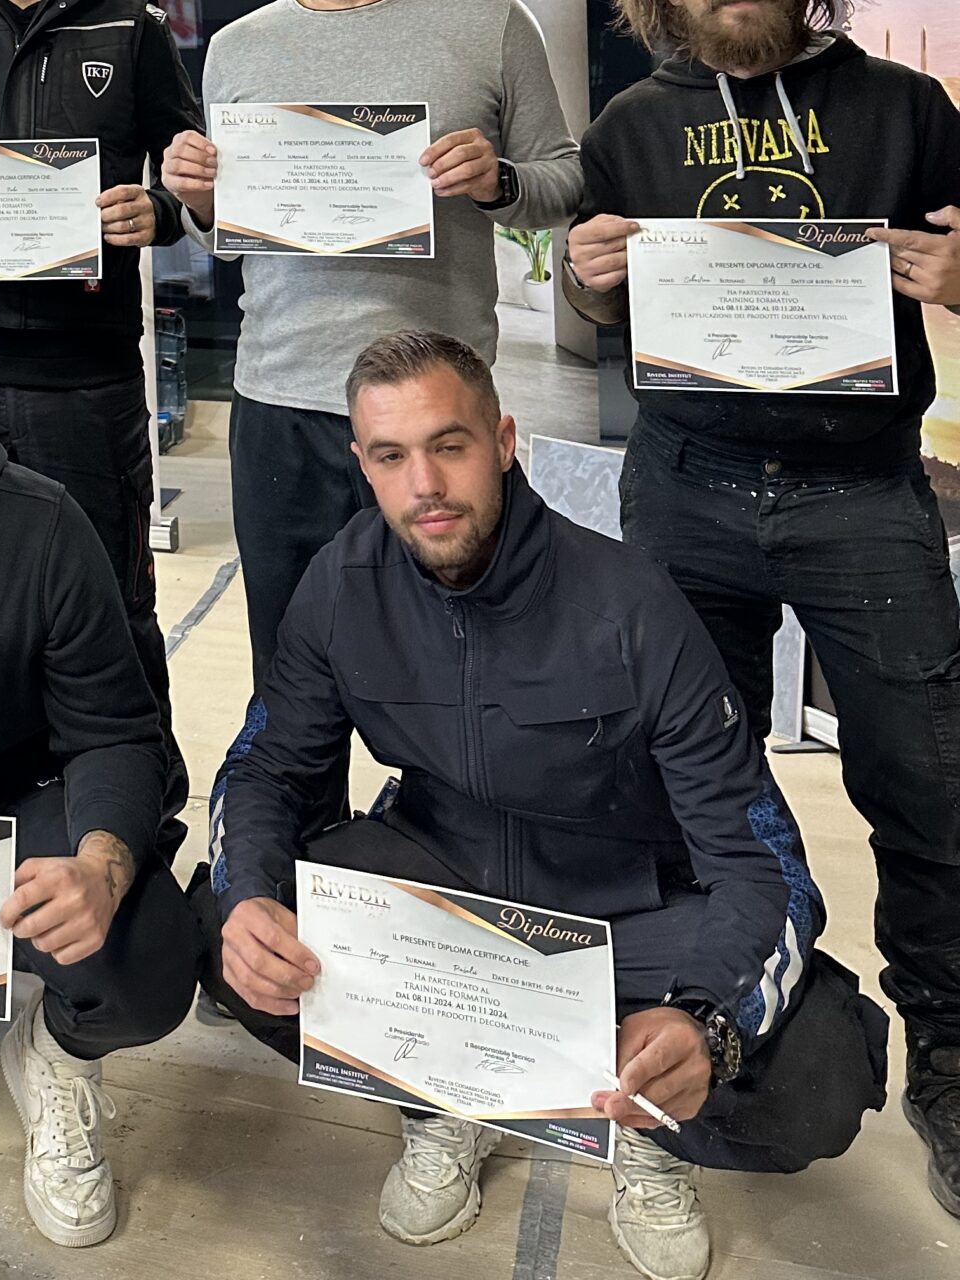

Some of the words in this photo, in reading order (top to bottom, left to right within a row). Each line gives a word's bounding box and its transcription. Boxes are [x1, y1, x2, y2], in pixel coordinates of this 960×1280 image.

[86, 66, 110, 79] IKF
[350, 106, 417, 128] Diploma
[32, 142, 88, 163] Diploma
[312, 874, 391, 907] RIVEDIL
[496, 907, 592, 945] Diploma
[392, 932, 399, 941] IL
[400, 934, 436, 949] PRESENTE
[437, 941, 472, 956] DIPLOMA
[473, 949, 512, 964] CERTIFICA
[414, 972, 426, 982] HA
[428, 975, 479, 993] PARTECIPATO
[480, 986, 490, 995] AL
[492, 974, 508, 983] DATE
[510, 977, 520, 986] OF
[521, 979, 543, 990] BIRTH:
[395, 991, 410, 1000] DAL
[455, 1002, 465, 1011] AL
[404, 981, 447, 997] TRAINING
[449, 990, 501, 1007] FORMATIVO
[345, 991, 360, 1001] PER
[421, 1007, 435, 1017] DEI
[436, 1010, 477, 1025] PRODOTTI
[479, 1018, 526, 1036] DECORATIVI
[528, 1028, 560, 1042] RIVEDIL
[315, 1062, 339, 1074] RIVEDIL
[340, 1068, 369, 1081] INSTITUT
